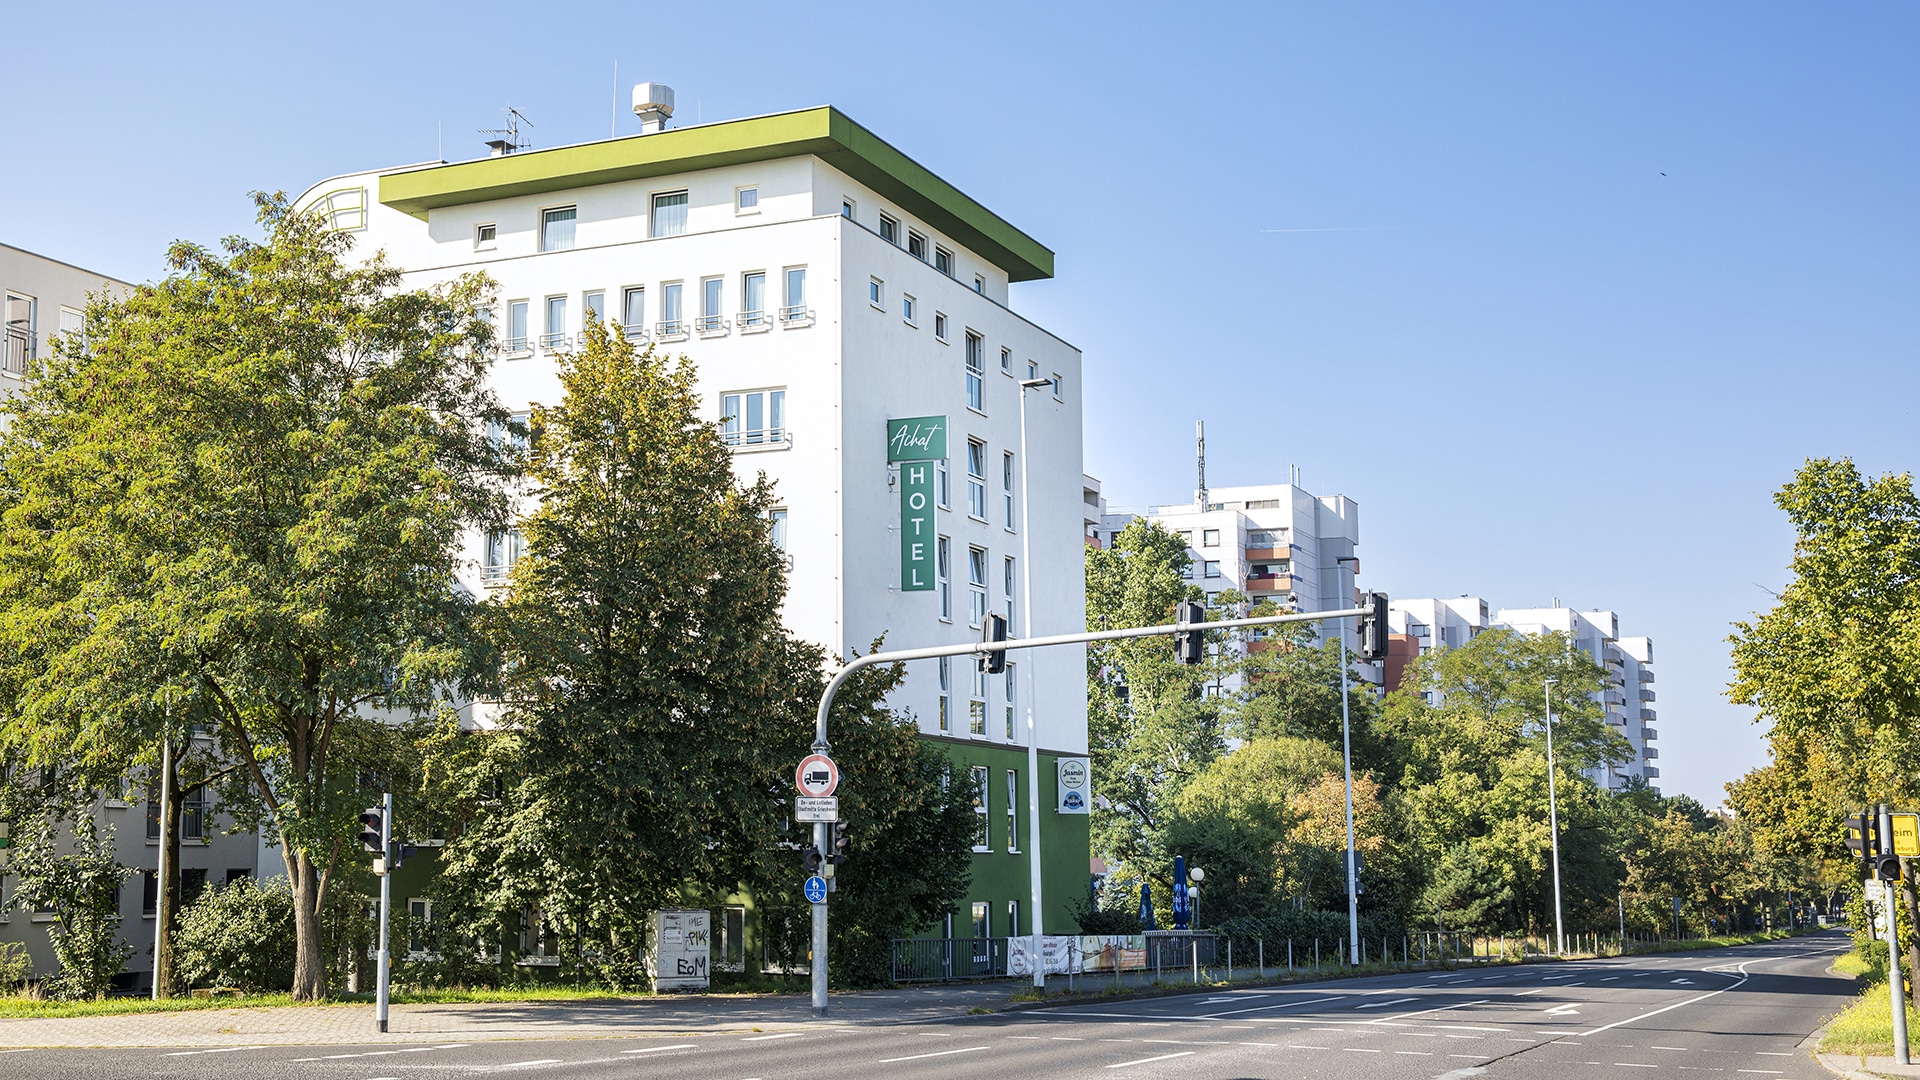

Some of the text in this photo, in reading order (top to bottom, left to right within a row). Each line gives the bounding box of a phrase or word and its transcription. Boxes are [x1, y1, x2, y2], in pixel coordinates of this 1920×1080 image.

[890, 423, 943, 455] Achat
[908, 466, 926, 587] HOTEL
[1063, 769, 1084, 777] Jasmin
[1893, 827, 1913, 837] eim
